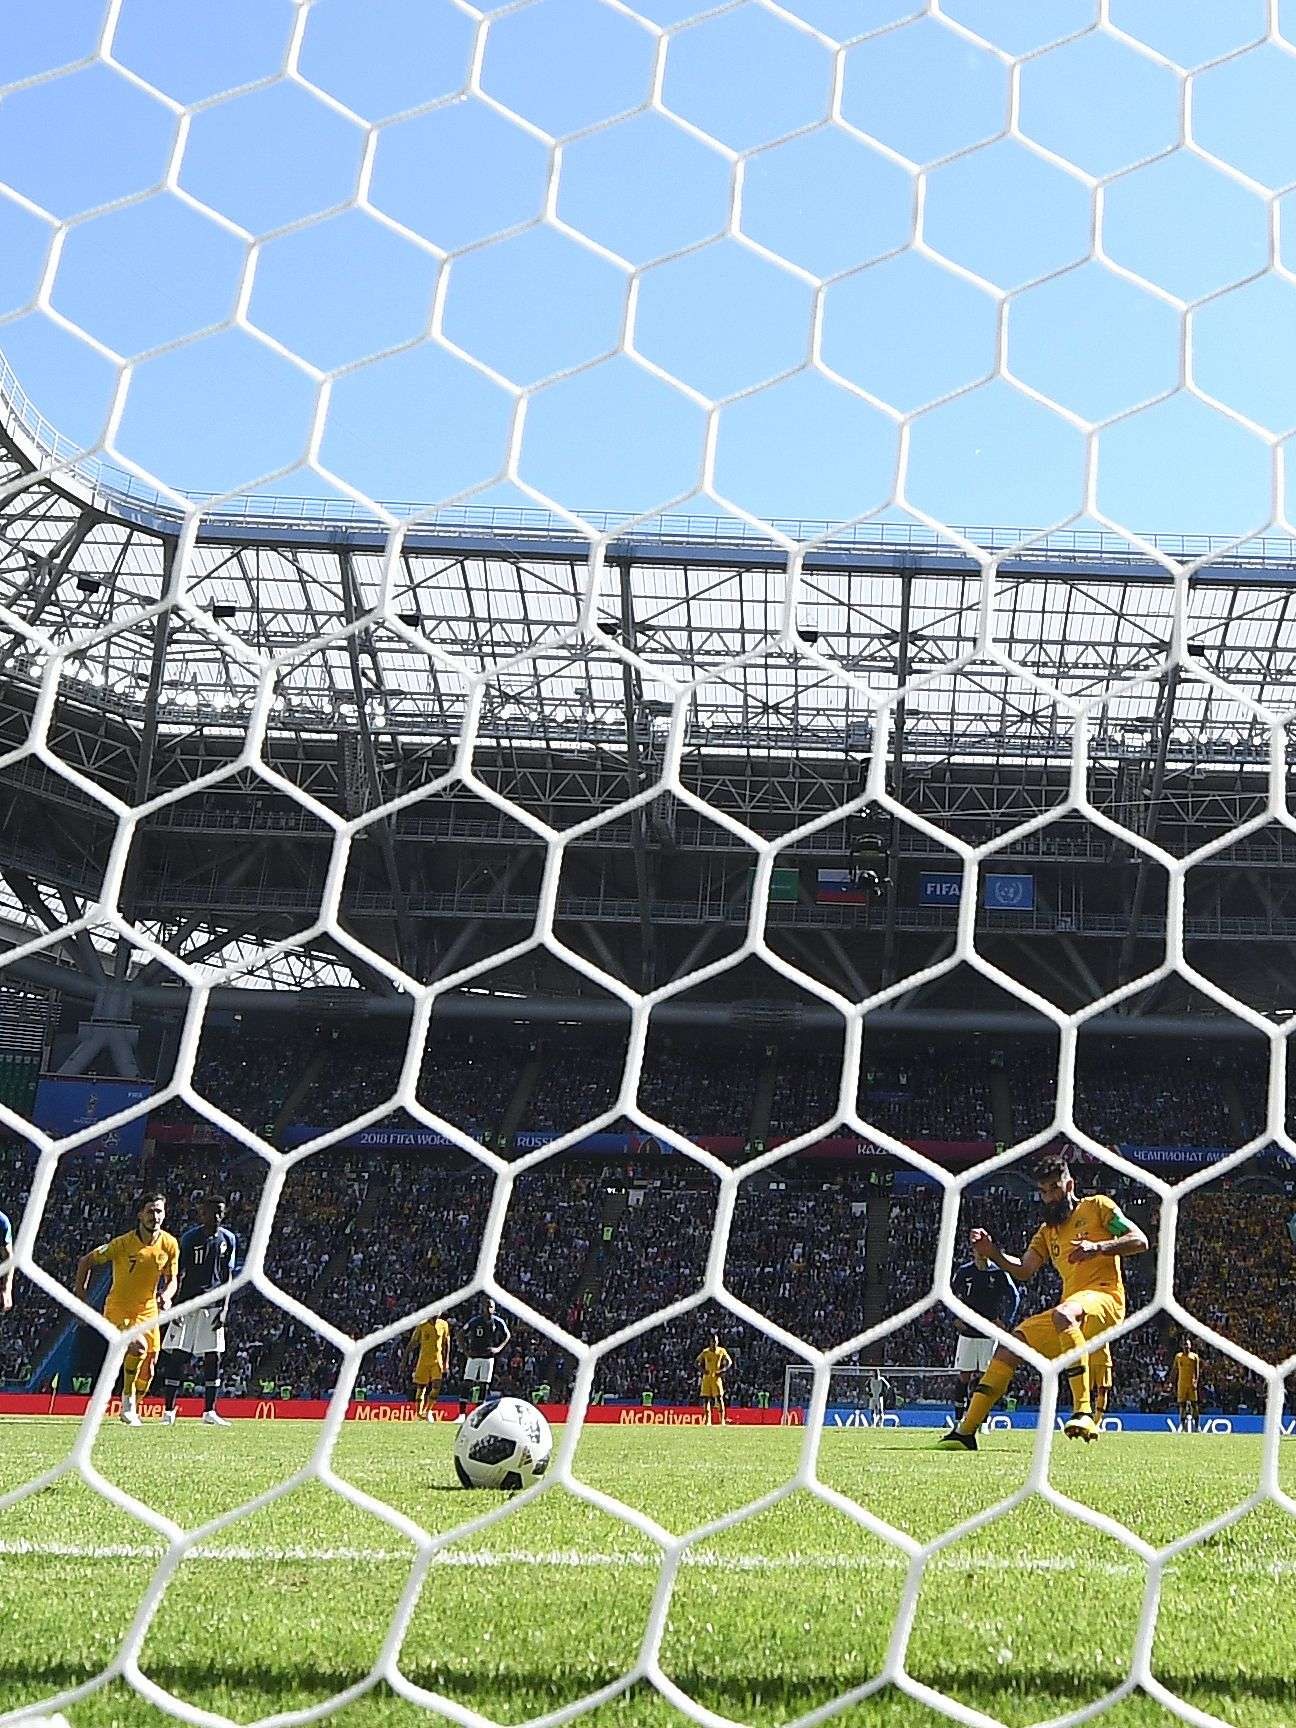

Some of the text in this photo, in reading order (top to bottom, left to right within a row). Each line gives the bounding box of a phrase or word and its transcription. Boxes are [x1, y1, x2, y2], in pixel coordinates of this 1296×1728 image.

[926, 883, 961, 896] FIFA
[360, 1132, 456, 1146] 2018 FIFA WOR
[516, 1136, 552, 1148] RUSS
[1133, 1150, 1202, 1162] ЧЕМПИОНАТ
[128, 1259, 137, 1273] 7
[355, 1404, 445, 1421] McDelivy
[620, 1409, 707, 1425] McDelivery
